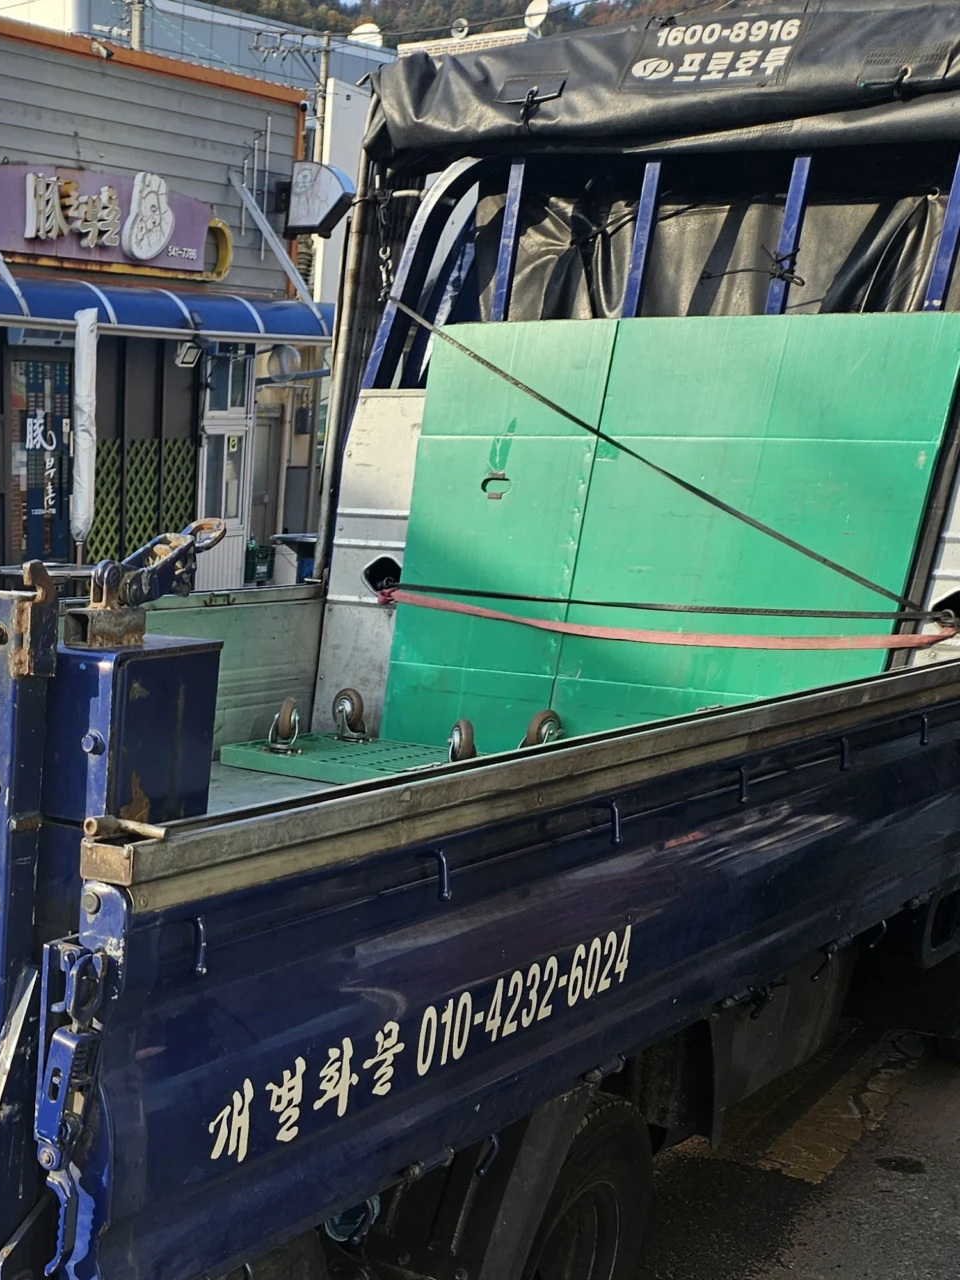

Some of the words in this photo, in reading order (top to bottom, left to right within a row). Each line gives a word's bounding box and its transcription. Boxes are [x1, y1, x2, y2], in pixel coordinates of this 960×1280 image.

[656, 18, 802, 47] 1600-8916
[672, 46, 792, 82] 프로호루
[208, 1020, 406, 1163] 개별화물
[416, 924, 633, 1077] 010-4232-6024
